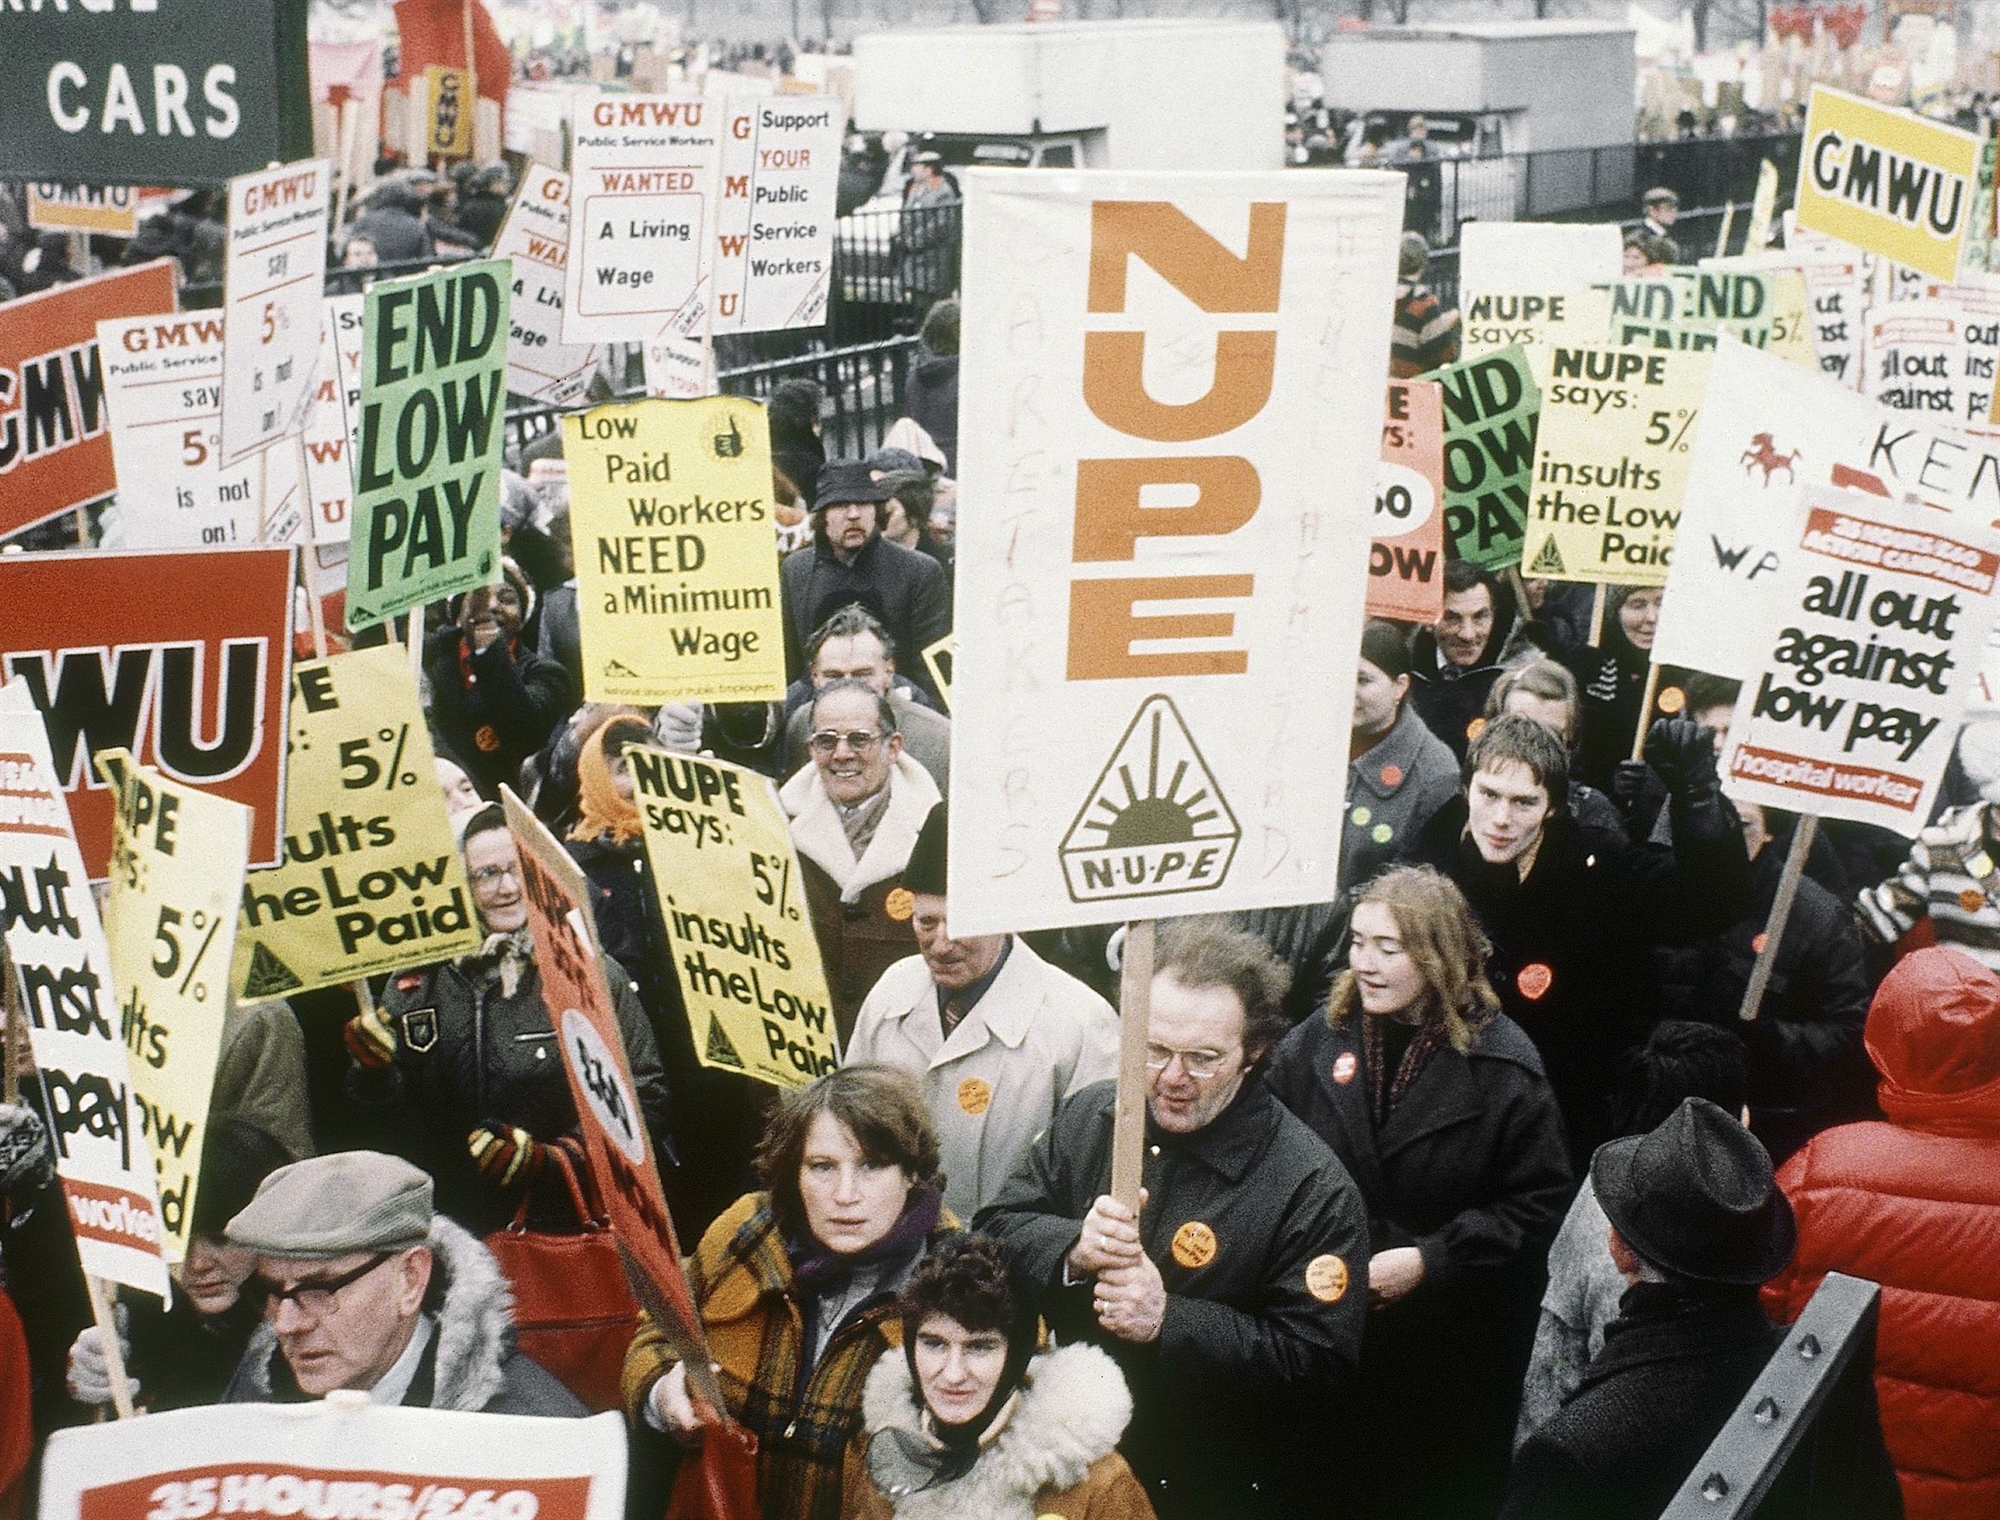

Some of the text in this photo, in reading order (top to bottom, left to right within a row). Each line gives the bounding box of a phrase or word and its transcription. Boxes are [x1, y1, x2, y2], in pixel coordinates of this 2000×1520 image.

[47, 61, 240, 139] CARS
[593, 102, 704, 128] GMWU
[762, 110, 830, 131] Support
[578, 135, 714, 148] Public Service Workers
[760, 149, 810, 168] YOUR
[244, 171, 316, 216] GMWU
[601, 172, 694, 193] WANTED
[755, 186, 808, 204] Public
[1813, 131, 1963, 234] GMWU
[520, 200, 555, 220] Public
[600, 219, 690, 242] A Living
[753, 222, 817, 240] Service
[597, 267, 654, 289] Wage
[751, 257, 821, 278] Workers
[512, 279, 524, 296] A
[1591, 283, 1674, 322] ND
[1468, 295, 1565, 322] NUPE
[375, 272, 500, 387] END
[510, 319, 548, 347] age
[1468, 326, 1544, 346] says:
[110, 355, 218, 376] Public Service
[1552, 347, 1667, 385] NUPE
[1904, 352, 1949, 379] out
[183, 385, 220, 410] say
[1550, 384, 1638, 414] says:
[359, 369, 502, 495] LOW
[580, 414, 638, 439] Low
[1066, 200, 1287, 681] NUPE
[1645, 409, 1698, 453] 5%
[182, 430, 220, 466] 5
[606, 452, 671, 483] Paid
[1540, 450, 1661, 491] insults
[177, 478, 250, 508] is not
[628, 495, 765, 526] Workers
[1536, 490, 1682, 530] the Low
[368, 471, 485, 592] PAY
[599, 534, 705, 574] NEED
[604, 582, 772, 614] a Minimum
[1803, 571, 1961, 641] all out
[670, 626, 759, 661] Wage
[1774, 627, 1955, 695] against
[1753, 672, 1940, 762] low pay
[339, 723, 418, 791] 5%
[1734, 747, 1921, 804] hospital worker
[631, 751, 745, 816] NUPE
[647, 803, 733, 849] says:
[242, 855, 449, 927] he Low
[750, 852, 799, 921] 5%
[336, 887, 469, 955] Paid
[668, 894, 791, 971] insults
[152, 904, 222, 1002] 5%
[684, 951, 826, 1034] the Low
[42, 1068, 130, 1171] pay
[147, 1476, 218, 1520] 35
